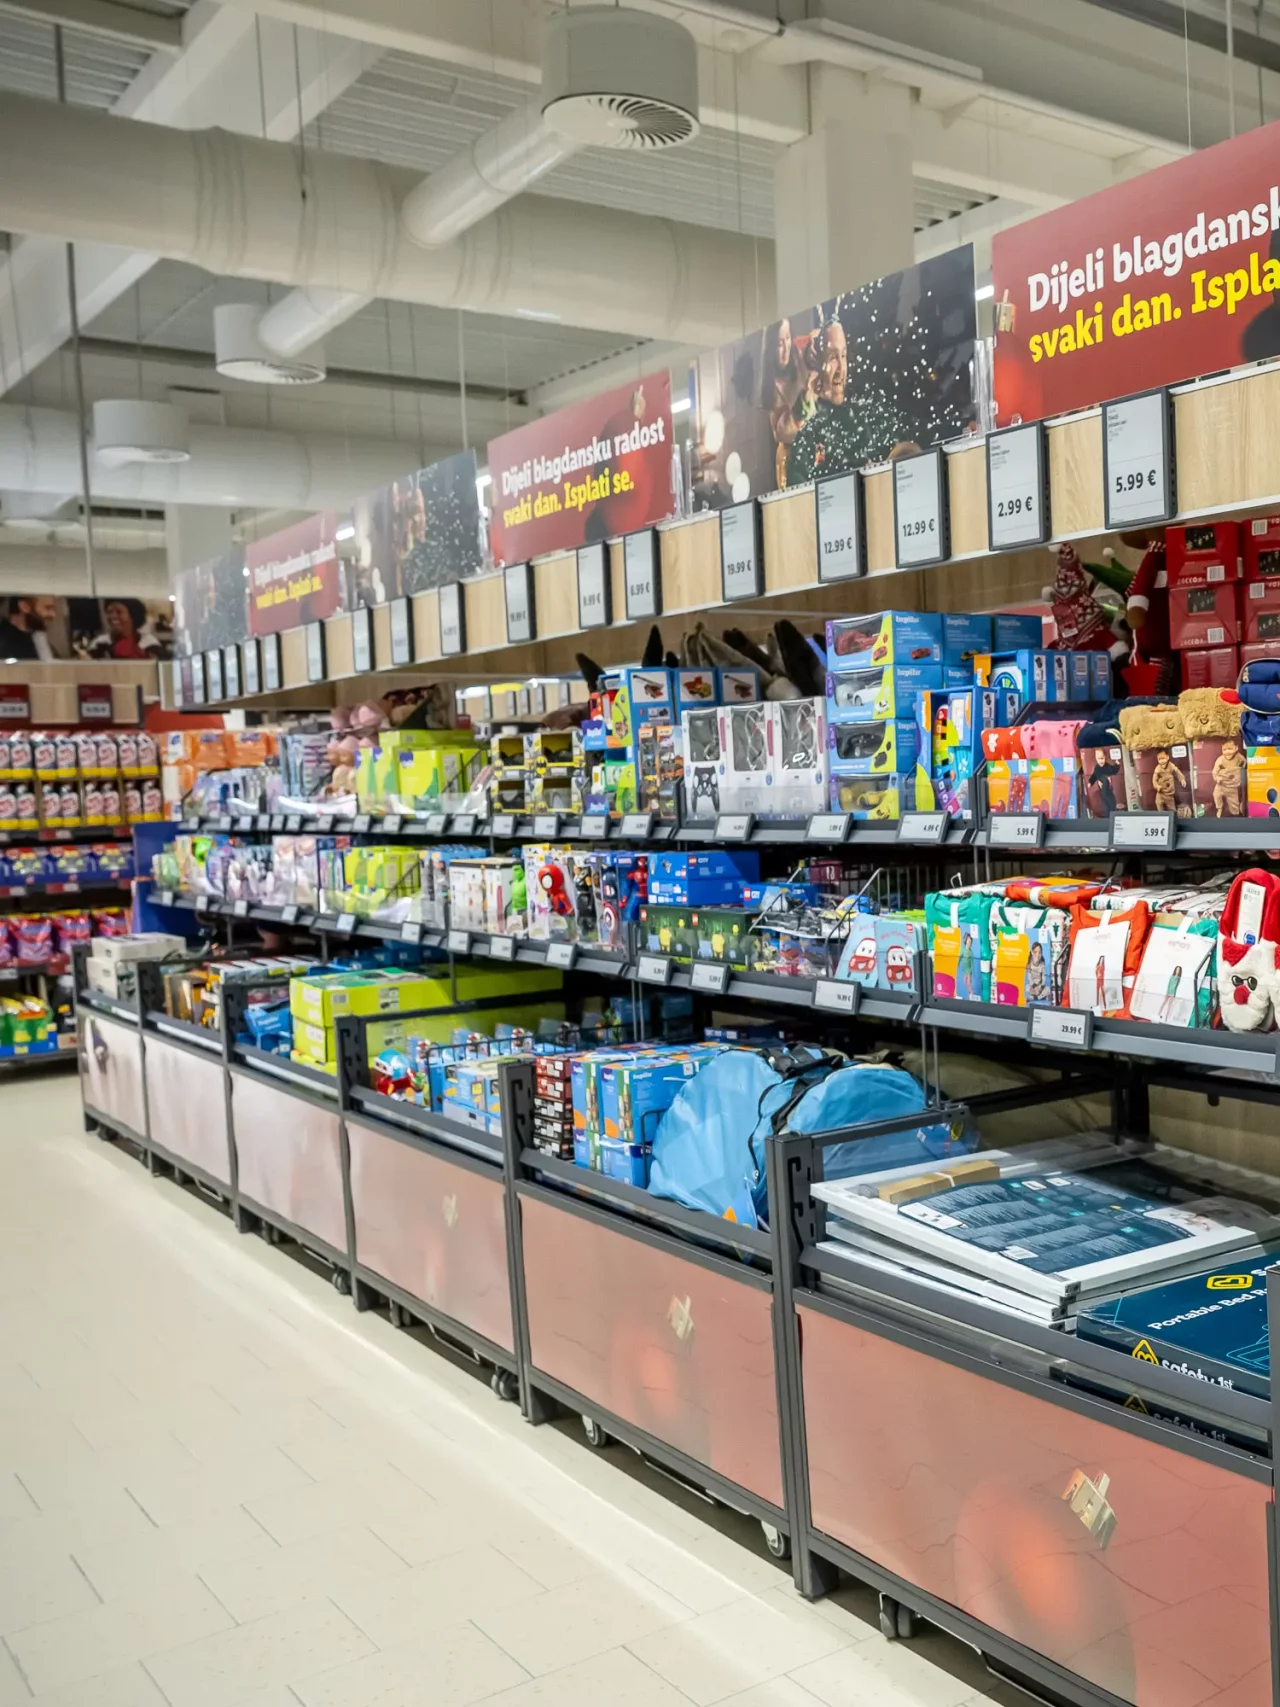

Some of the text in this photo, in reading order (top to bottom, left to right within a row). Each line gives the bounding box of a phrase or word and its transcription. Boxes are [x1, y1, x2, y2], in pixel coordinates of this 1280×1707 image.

[1027, 249, 1104, 314] Dijeli
[1028, 299, 1103, 363] svaki
[1111, 287, 1182, 336] dan.
[502, 416, 665, 498] Dijeli blagdansku radost
[1116, 470, 1156, 493] 5.99 €
[503, 467, 635, 528] svaki dan. Isplati se.
[998, 496, 1032, 517] 2.99 €
[903, 518, 934, 537] 12.99 €
[824, 537, 852, 554] 12.99 €
[1017, 827, 1034, 836] 5.99 €
[1145, 827, 1165, 837] 5.99 €
[1061, 1024, 1081, 1035] 29.99 €
[1148, 1294, 1256, 1330] Portable Bed
